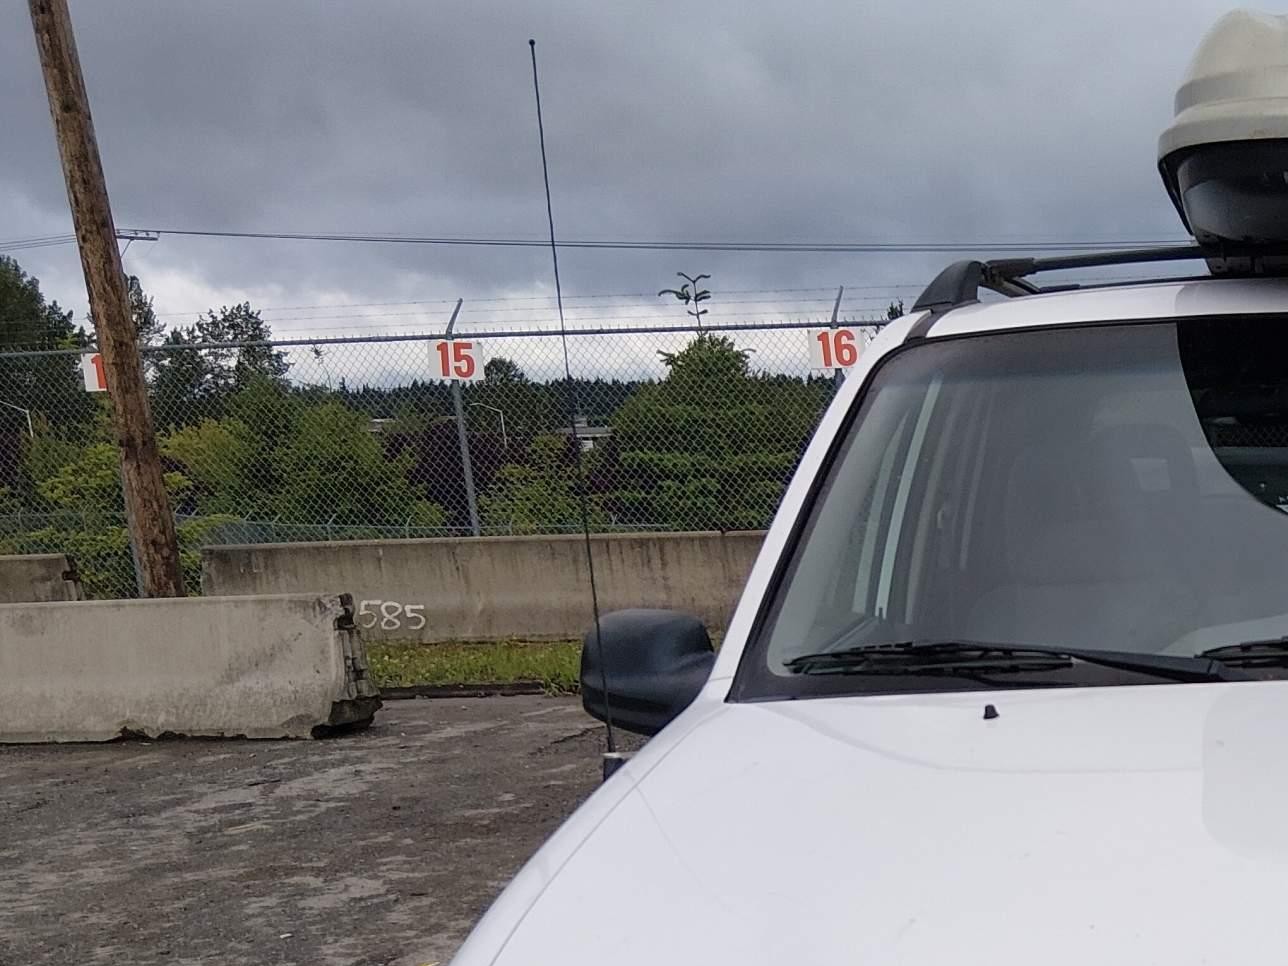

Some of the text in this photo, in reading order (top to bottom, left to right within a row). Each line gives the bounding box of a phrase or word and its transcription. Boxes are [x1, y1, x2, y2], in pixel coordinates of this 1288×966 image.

[437, 341, 475, 379] 15
[817, 331, 858, 368] 16
[359, 599, 426, 630] 585
